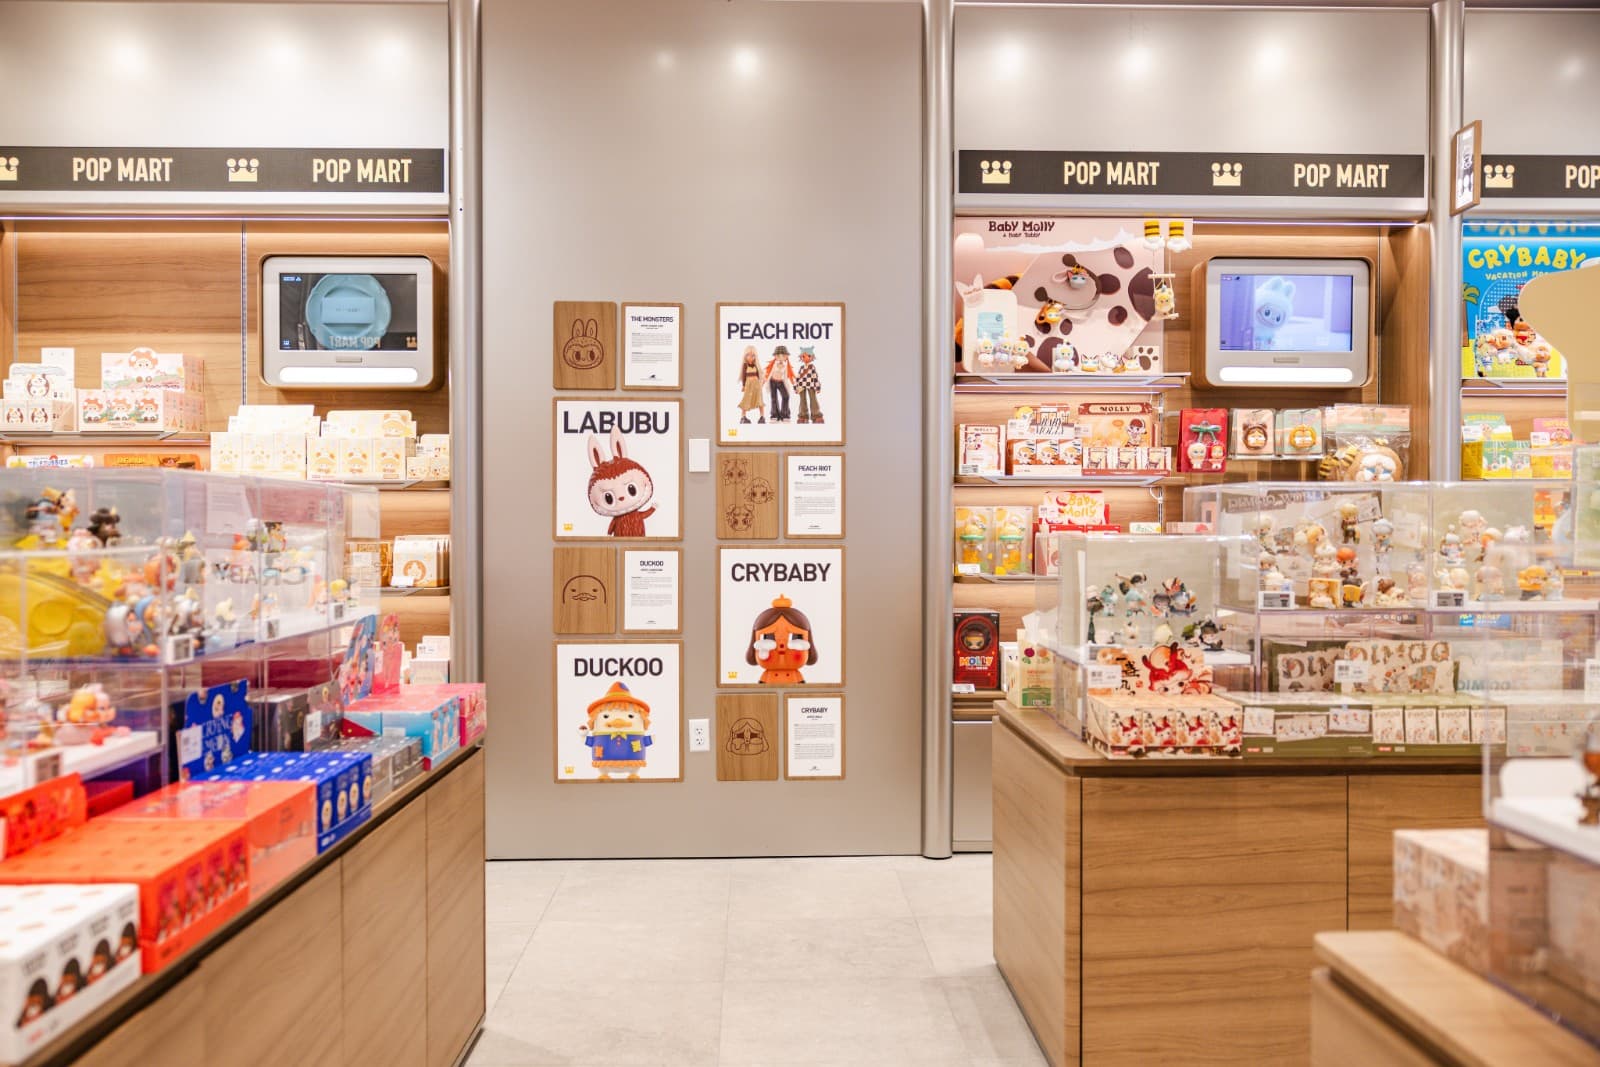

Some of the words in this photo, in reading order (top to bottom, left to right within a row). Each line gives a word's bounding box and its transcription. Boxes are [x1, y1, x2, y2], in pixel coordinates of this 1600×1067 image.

[72, 157, 111, 183] POP
[118, 157, 173, 183] MART
[312, 158, 351, 183] POP
[357, 158, 412, 183] MART
[1063, 161, 1101, 186] POP
[1106, 161, 1160, 187] MART
[1293, 163, 1331, 188] POP
[1336, 163, 1390, 188] MART
[1565, 165, 1600, 188] POP
[1468, 244, 1586, 269] CRYBABY
[1485, 270, 1528, 280] VACATION
[727, 322, 788, 340] PEACH
[792, 322, 833, 340] RIOT
[563, 410, 669, 434] LABUBU
[1068, 494, 1097, 506] Baby
[731, 562, 832, 582] CRYBABY
[574, 657, 663, 677] DUCKOO
[959, 656, 994, 667] MOLLY
